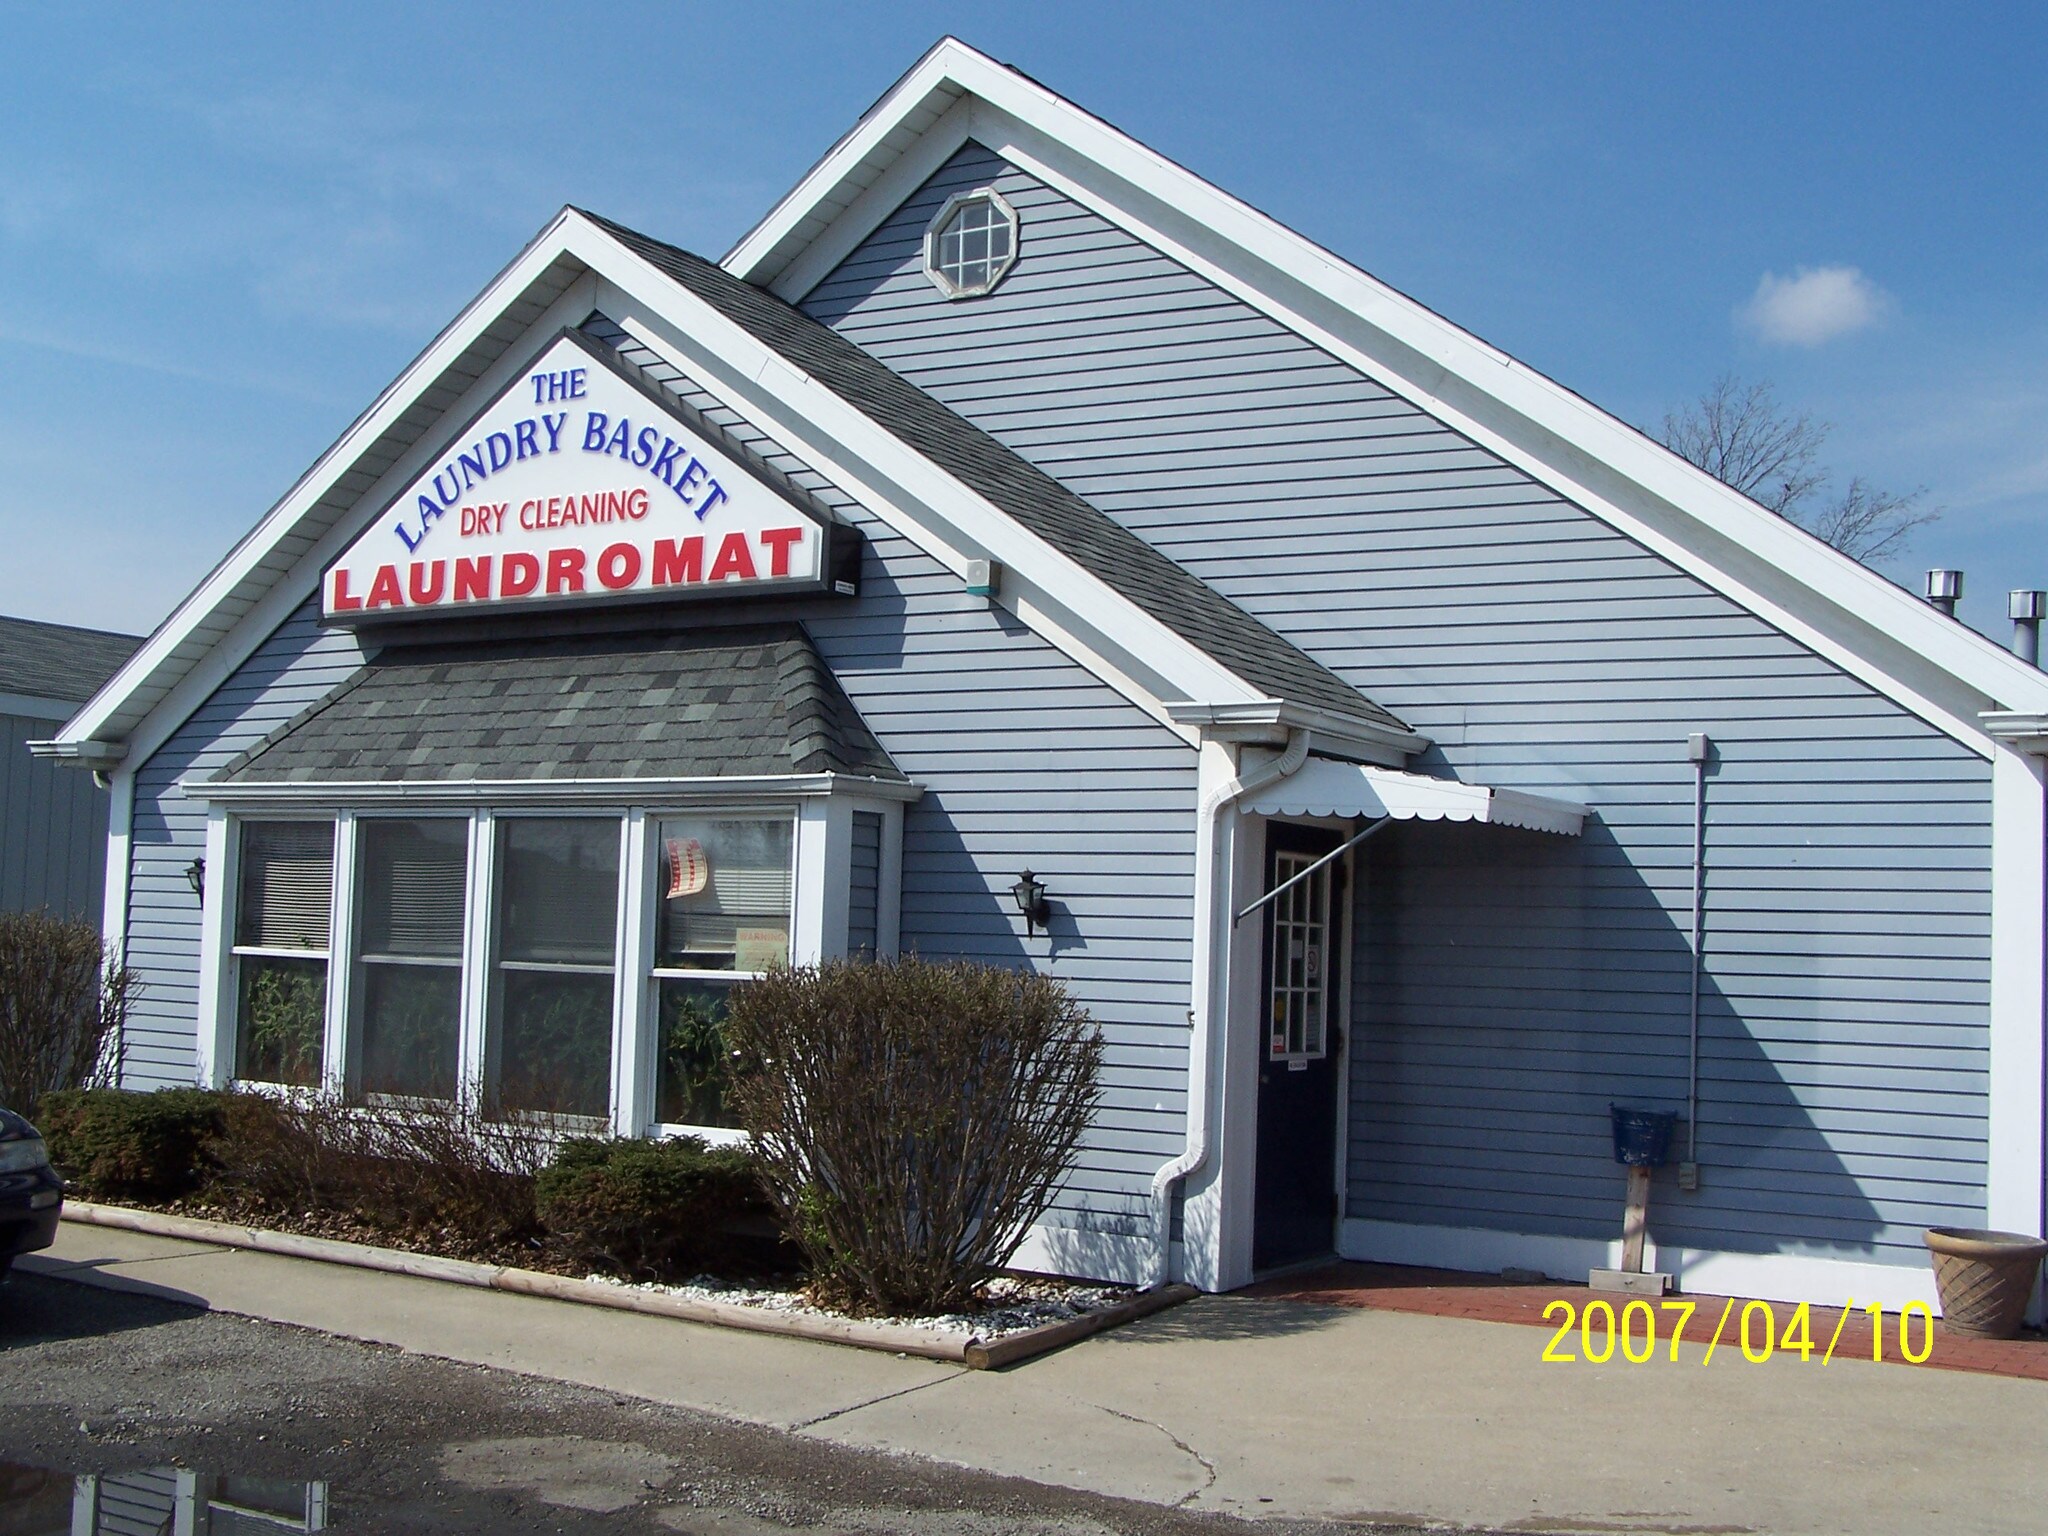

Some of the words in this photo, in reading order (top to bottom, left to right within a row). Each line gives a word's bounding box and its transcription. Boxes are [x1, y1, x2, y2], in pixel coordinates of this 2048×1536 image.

[531, 367, 587, 403] THE
[394, 412, 567, 552] LAUNDRY
[582, 411, 728, 521] BASKET
[460, 503, 507, 536] DRY
[520, 488, 649, 531] CLEANING
[333, 526, 804, 612] LAUNDROMAT
